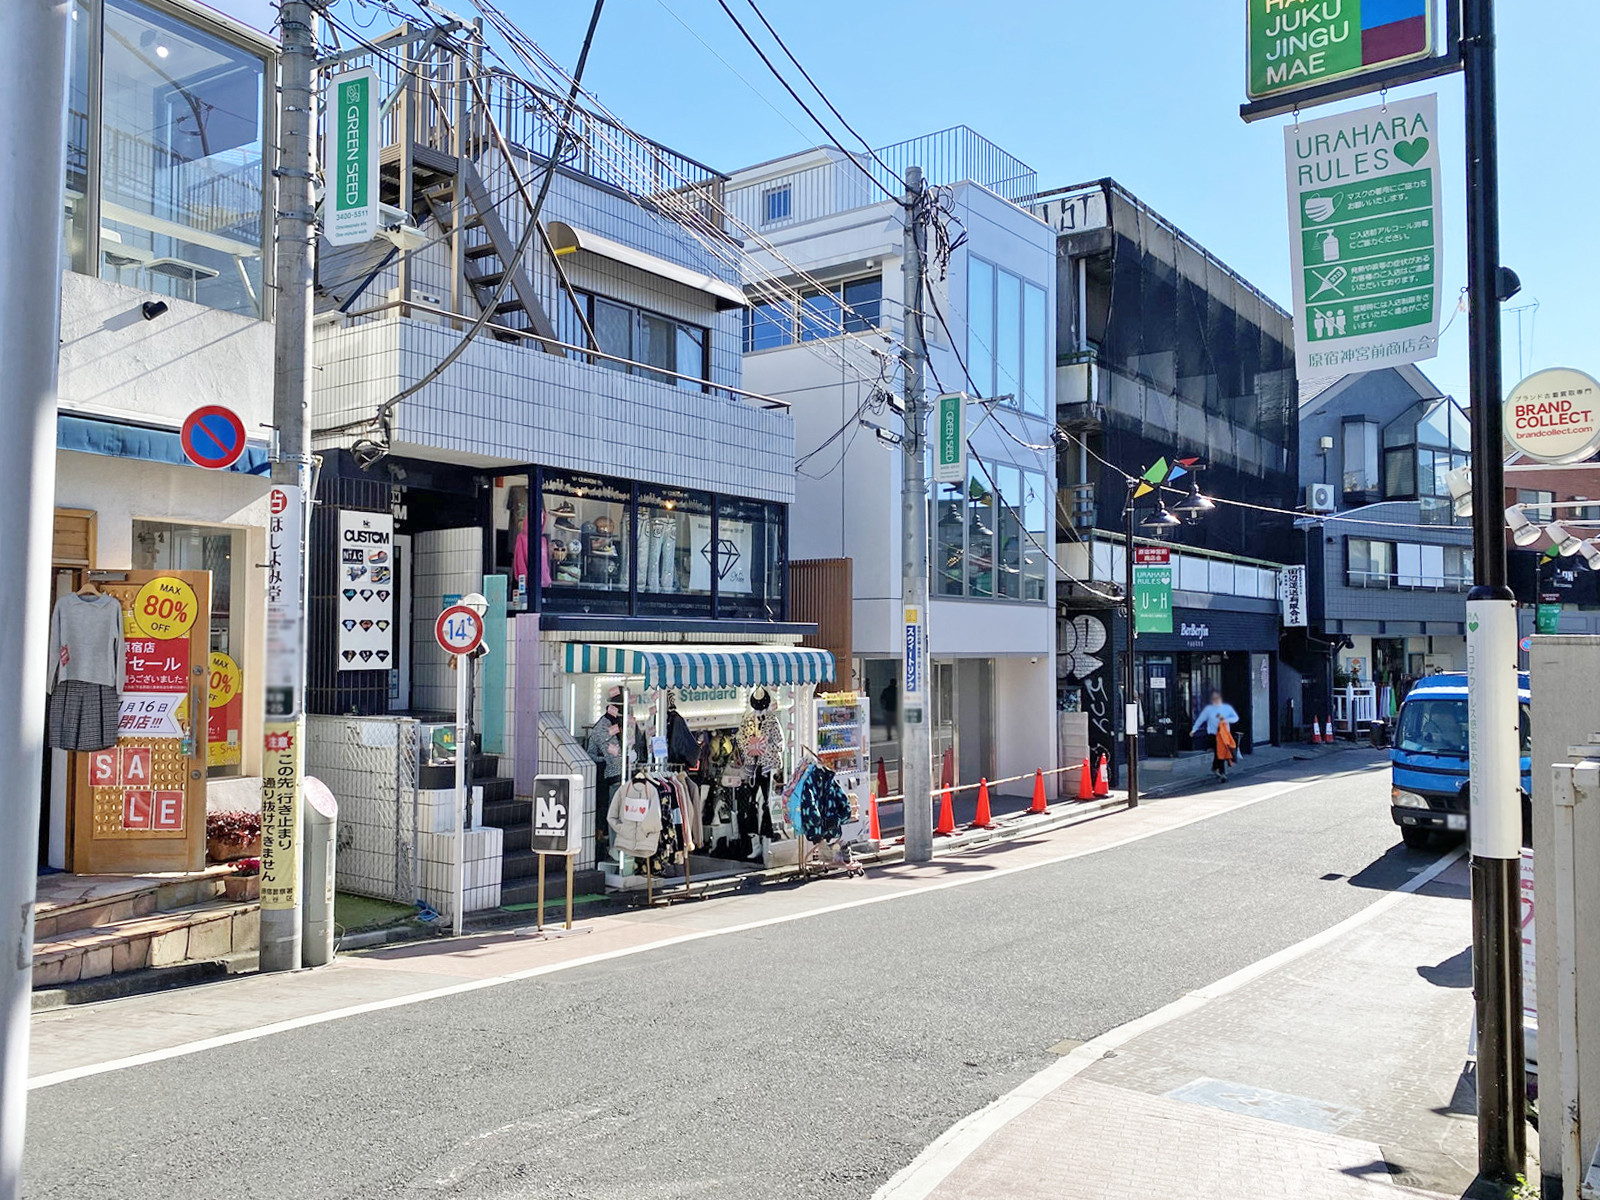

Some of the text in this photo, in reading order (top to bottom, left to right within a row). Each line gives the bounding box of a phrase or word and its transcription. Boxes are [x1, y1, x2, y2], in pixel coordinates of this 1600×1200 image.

[1266, 2, 1341, 37] JUKU
[1266, 21, 1349, 61] JINGU
[1267, 52, 1326, 86] MAE
[1296, 113, 1428, 159] URAHARA
[346, 106, 360, 205] GREEN SEED
[1298, 148, 1390, 186] RULES
[1353, 320, 1377, 330] います。
[1309, 335, 1430, 368] 原宿神宮前商店会
[1515, 400, 1572, 417] BRAND
[1515, 410, 1592, 429] COLLECT
[1516, 426, 1592, 439] brandcollect.com
[344, 529, 389, 544] CUSTOM
[1136, 571, 1170, 579] URAHARA
[160, 584, 181, 596] MAX
[144, 595, 188, 623] 80%
[151, 622, 170, 633] OFF
[125, 656, 181, 671] セール
[213, 658, 229, 669] MAX
[126, 674, 188, 684] うございました！
[210, 671, 233, 694] 0%
[680, 687, 737, 702] Standard
[261, 777, 276, 883] 通り抜けできません
